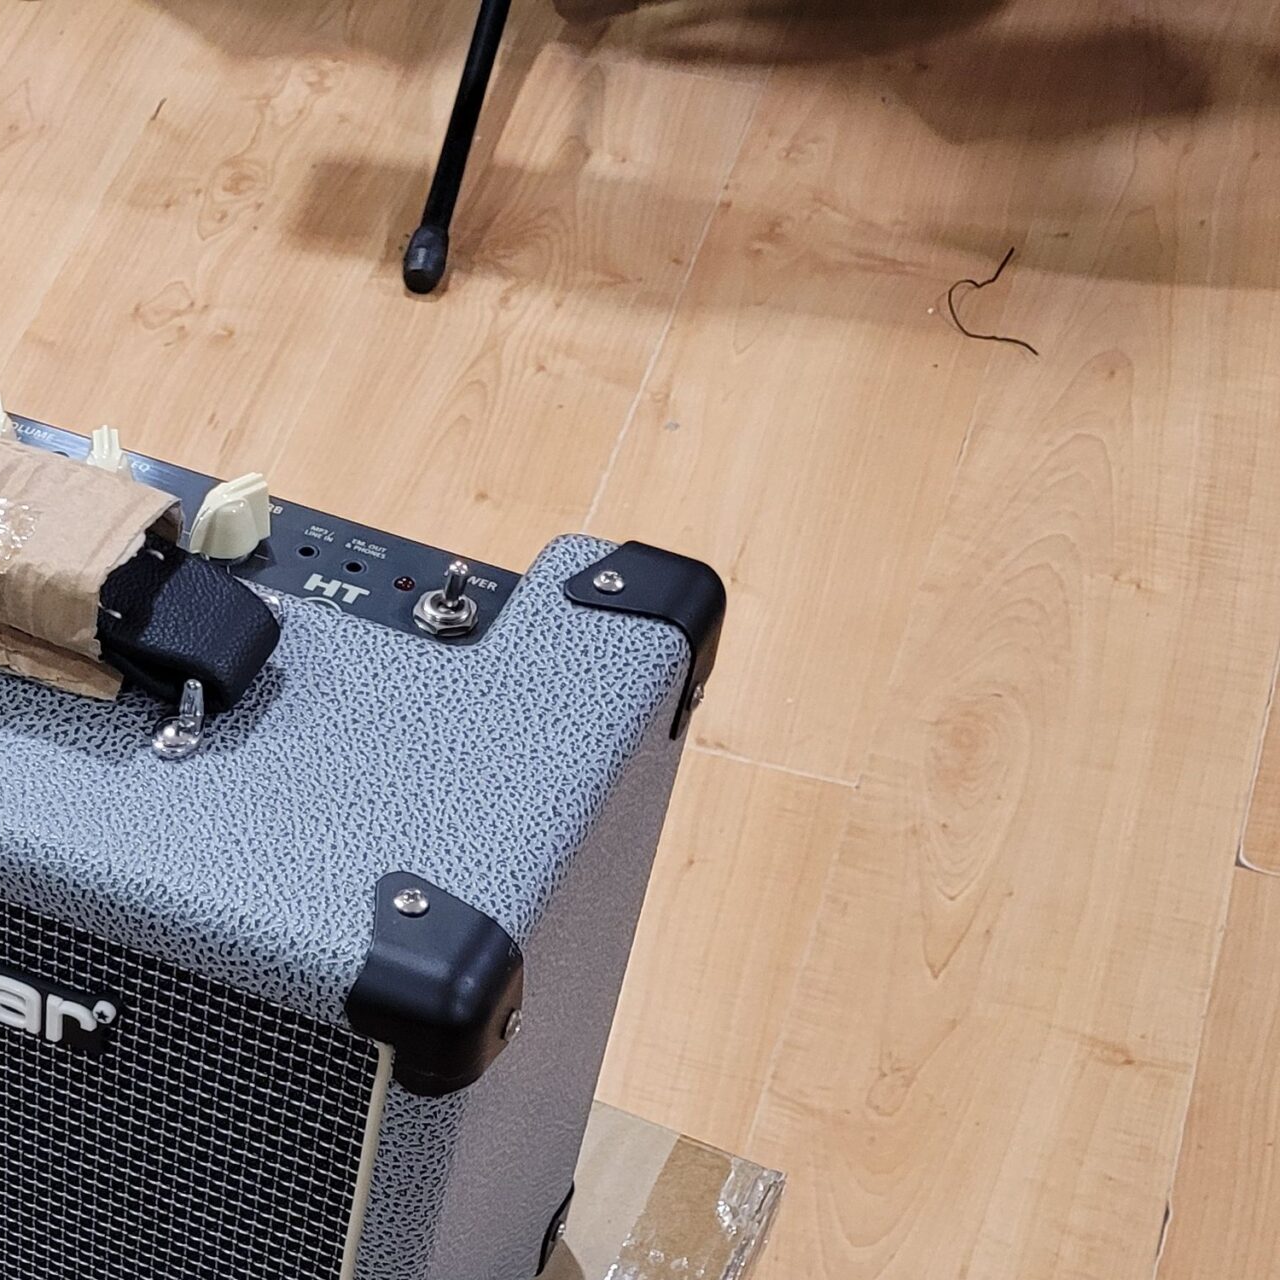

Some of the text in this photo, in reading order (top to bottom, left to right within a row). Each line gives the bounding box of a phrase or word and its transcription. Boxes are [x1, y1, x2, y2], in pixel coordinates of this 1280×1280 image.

[11, 421, 56, 441] OLUME
[131, 460, 151, 474] EQ
[353, 545, 387, 560] PHONES
[368, 543, 388, 554] OUT
[303, 572, 371, 605] HT
